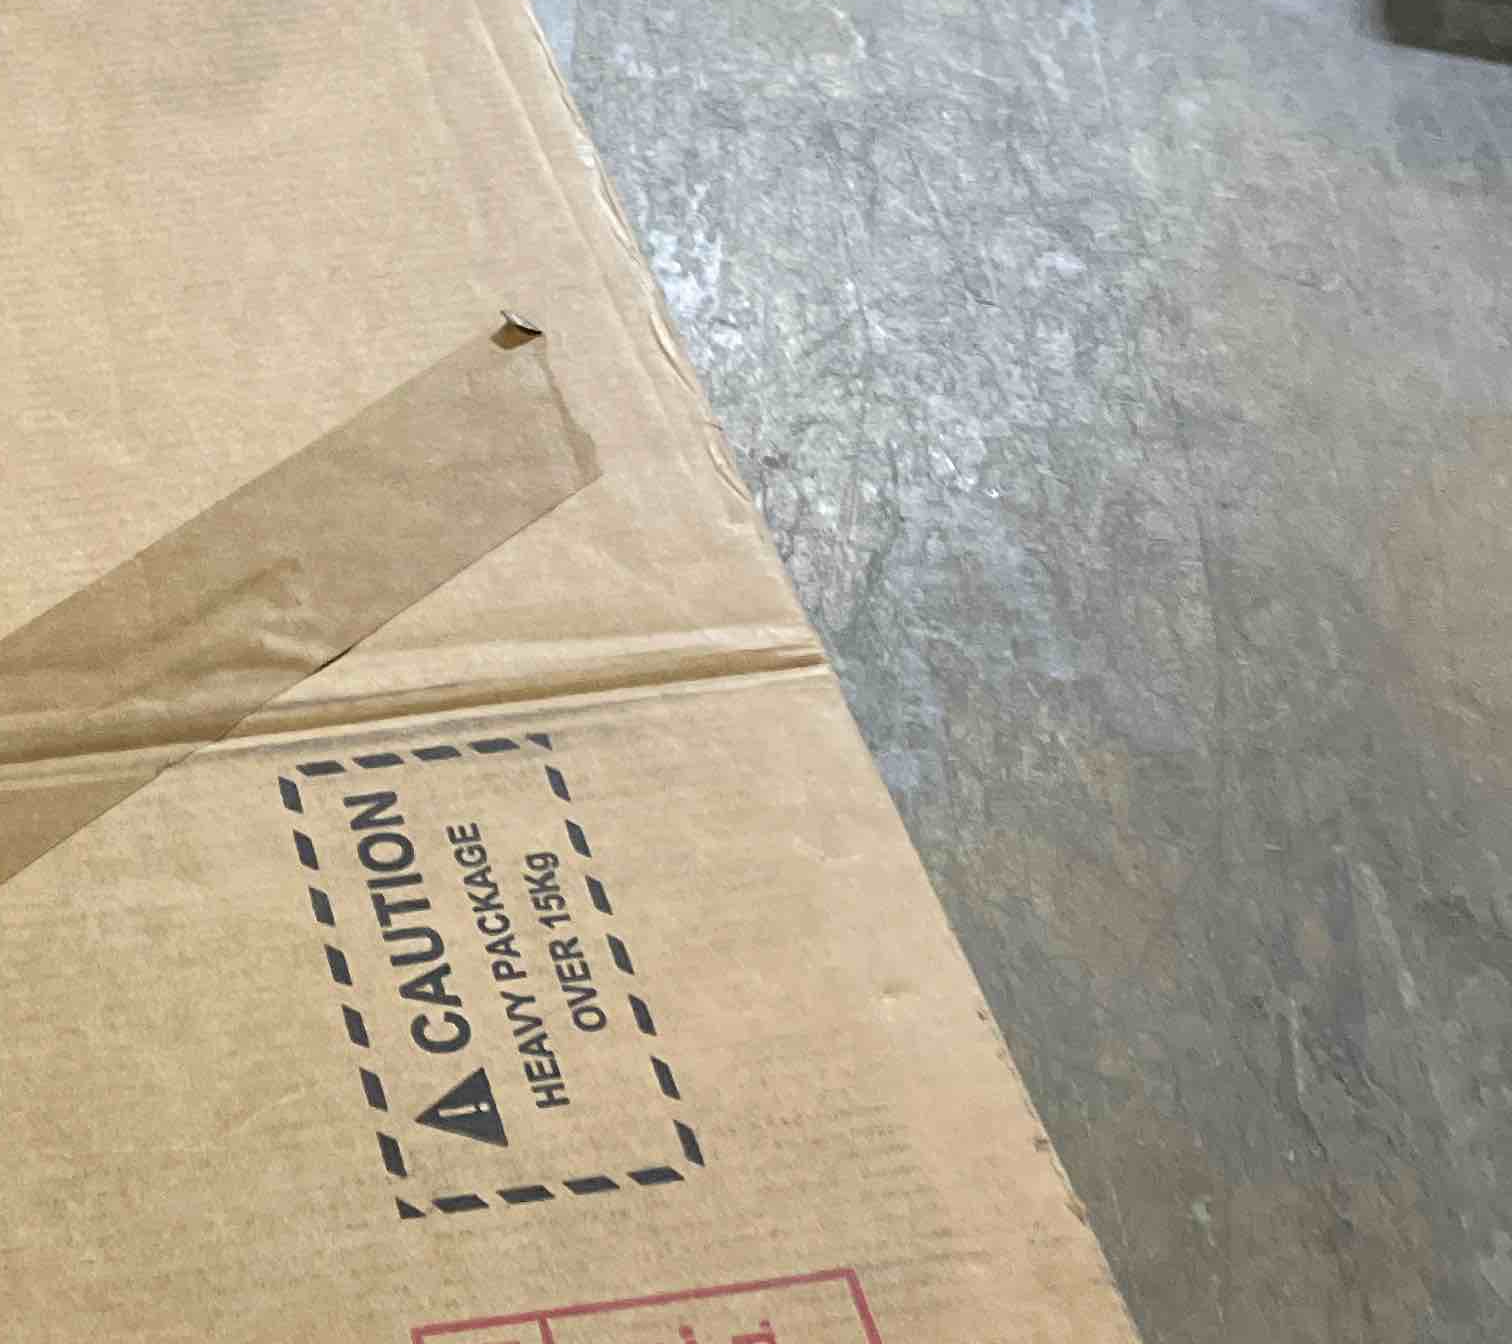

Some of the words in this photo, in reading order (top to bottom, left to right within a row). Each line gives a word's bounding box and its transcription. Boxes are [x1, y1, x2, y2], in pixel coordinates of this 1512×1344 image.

[343, 791, 472, 1054] CAUTION
[446, 822, 527, 981] PACKAGE
[500, 990, 570, 1109] HEAVY
[548, 936, 607, 1033] OVER
